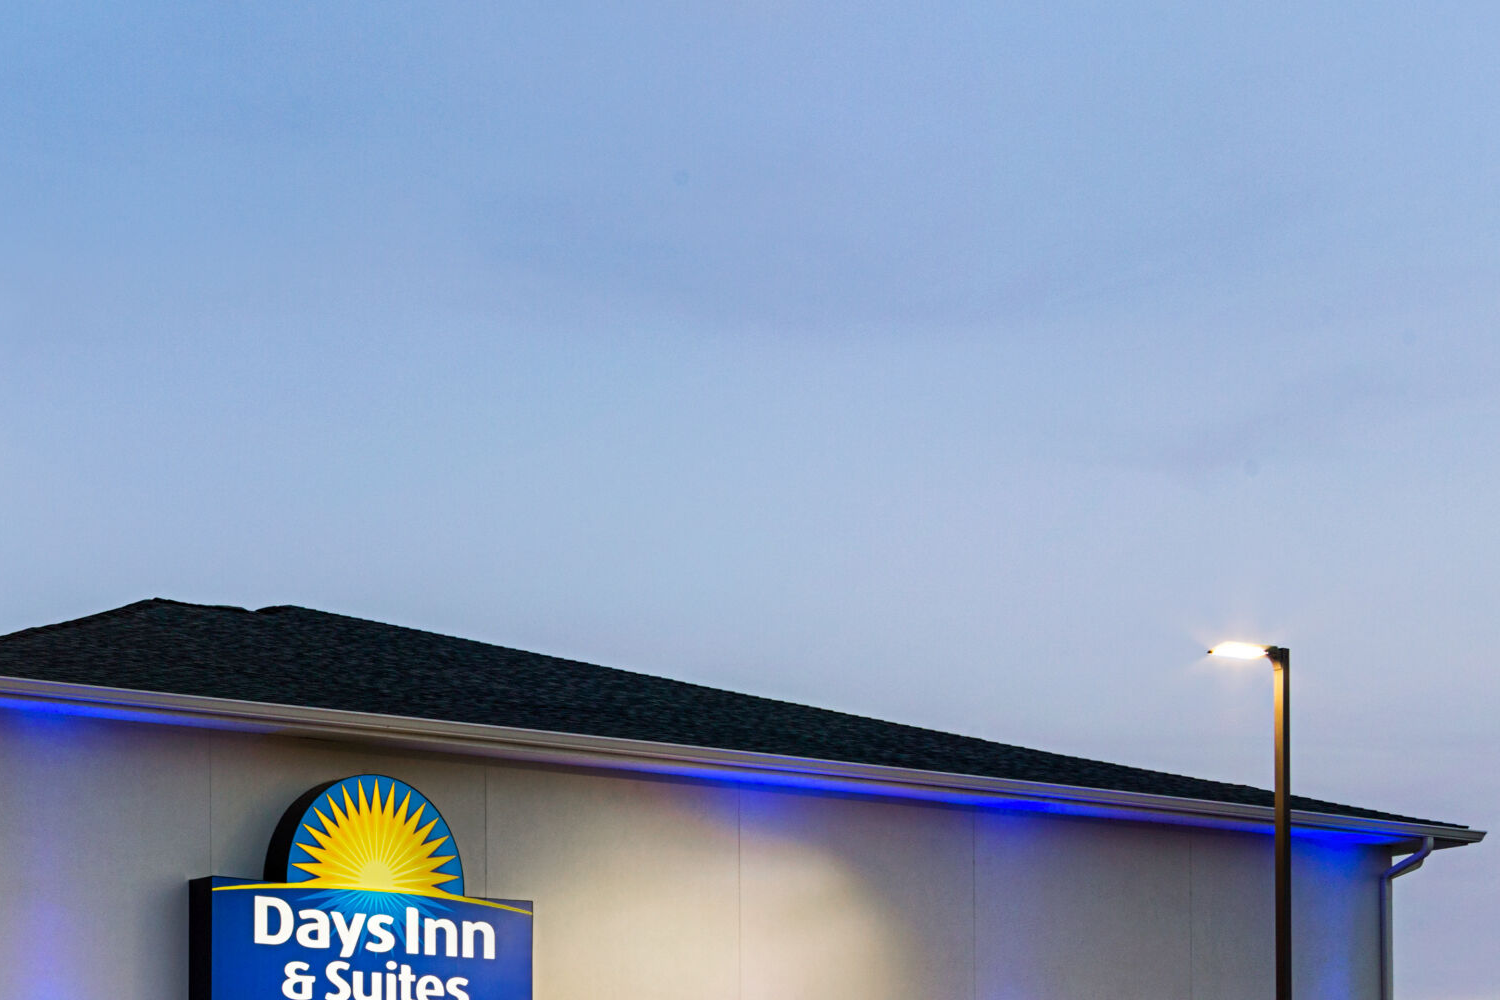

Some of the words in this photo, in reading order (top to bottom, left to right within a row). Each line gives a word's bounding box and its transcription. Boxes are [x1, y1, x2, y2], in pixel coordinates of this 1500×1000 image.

[254, 895, 396, 958] Days
[405, 907, 496, 960] Inn
[281, 961, 316, 1000] &
